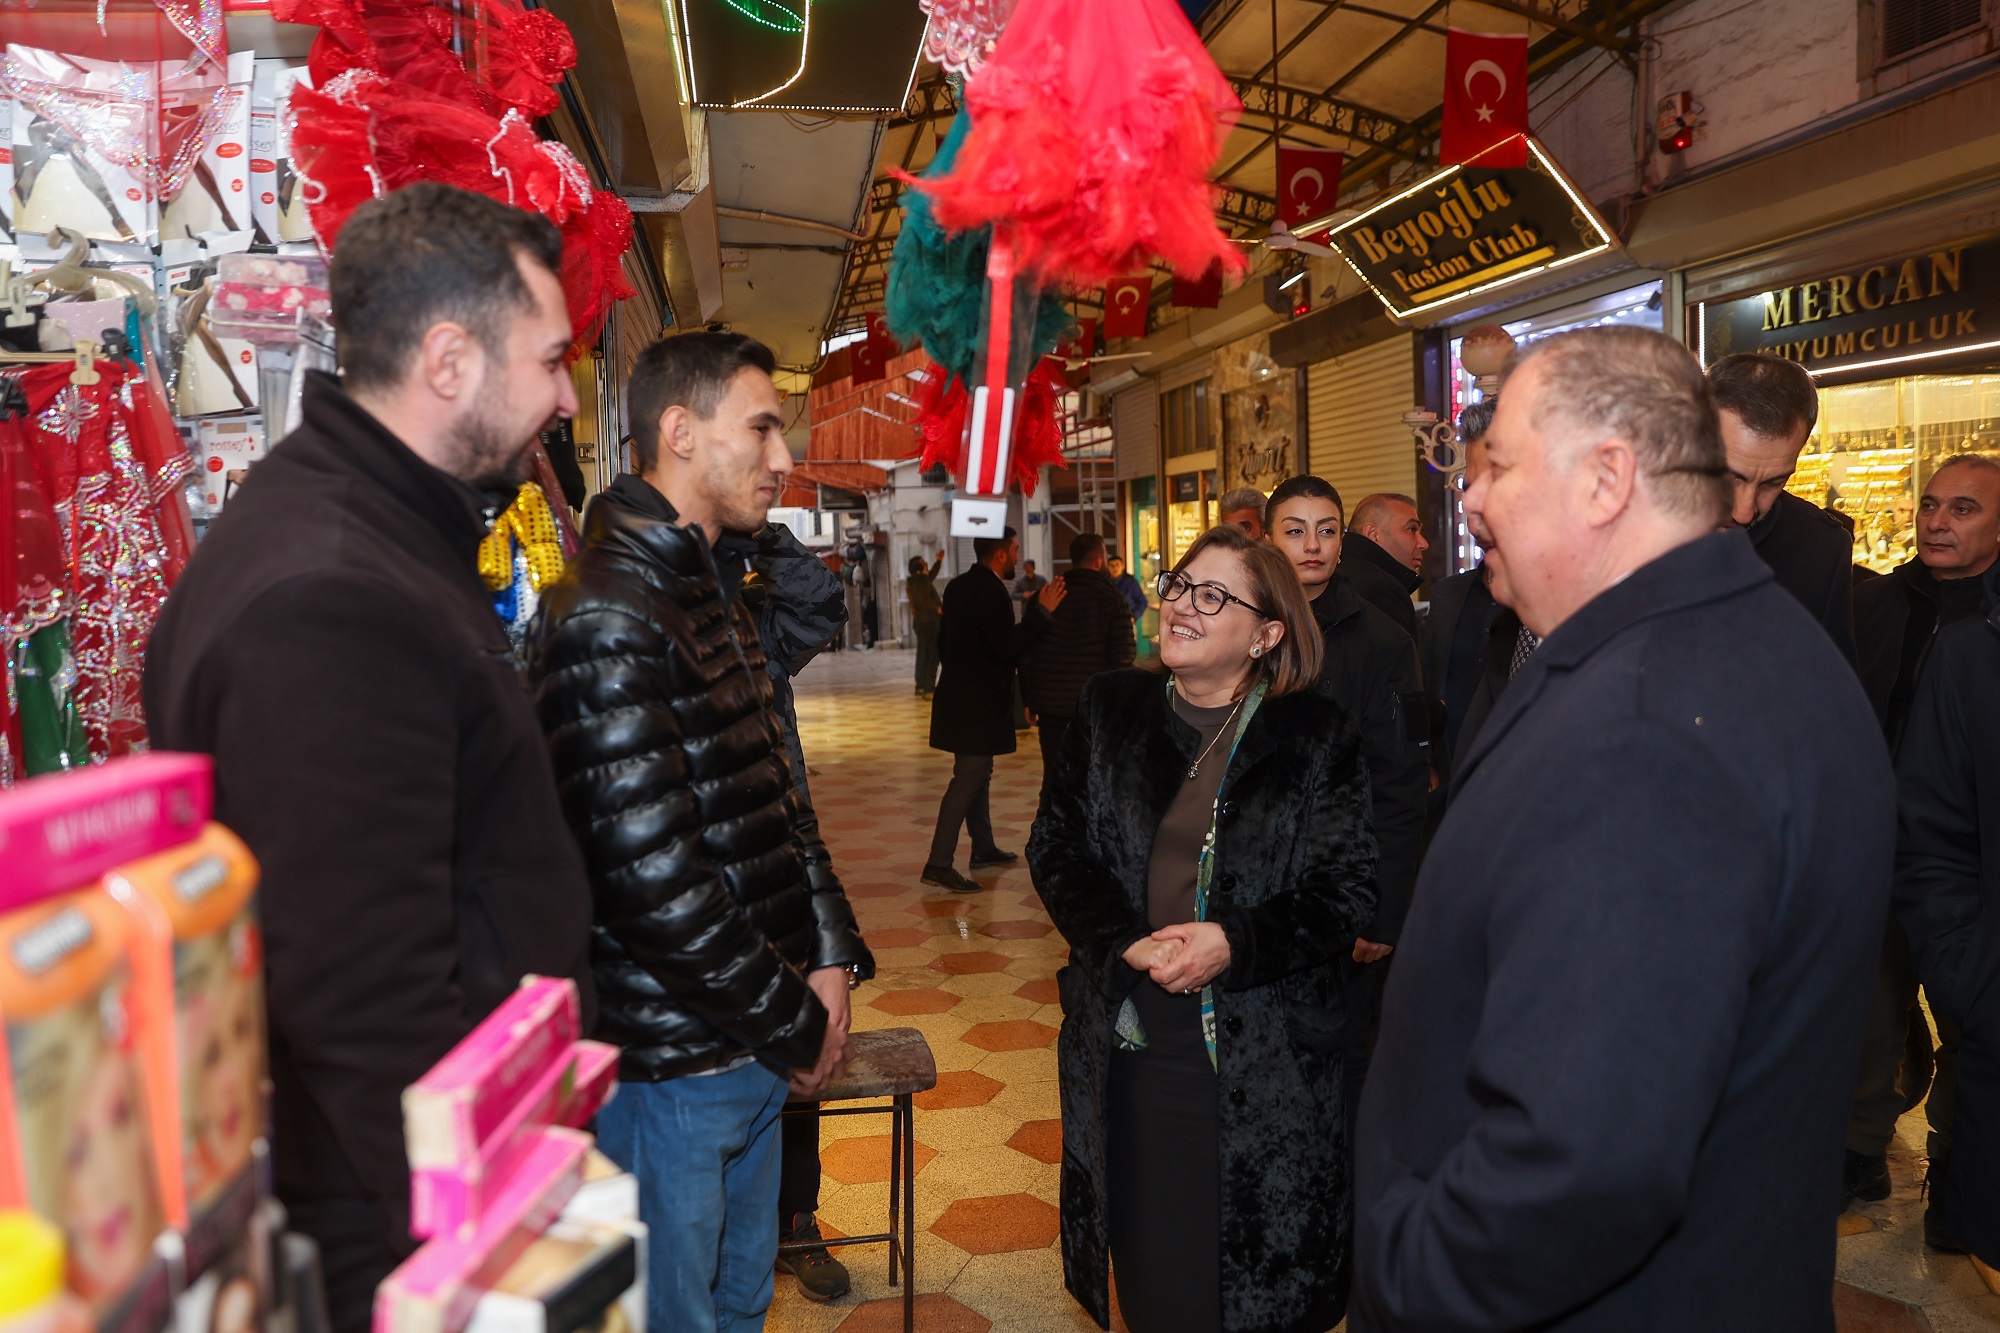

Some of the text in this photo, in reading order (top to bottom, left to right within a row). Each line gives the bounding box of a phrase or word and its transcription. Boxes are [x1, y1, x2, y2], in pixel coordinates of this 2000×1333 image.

[1351, 176, 1512, 265] Beyoğlu
[1390, 222, 1538, 292] Fasion Club
[1761, 247, 1966, 332] MERCAN
